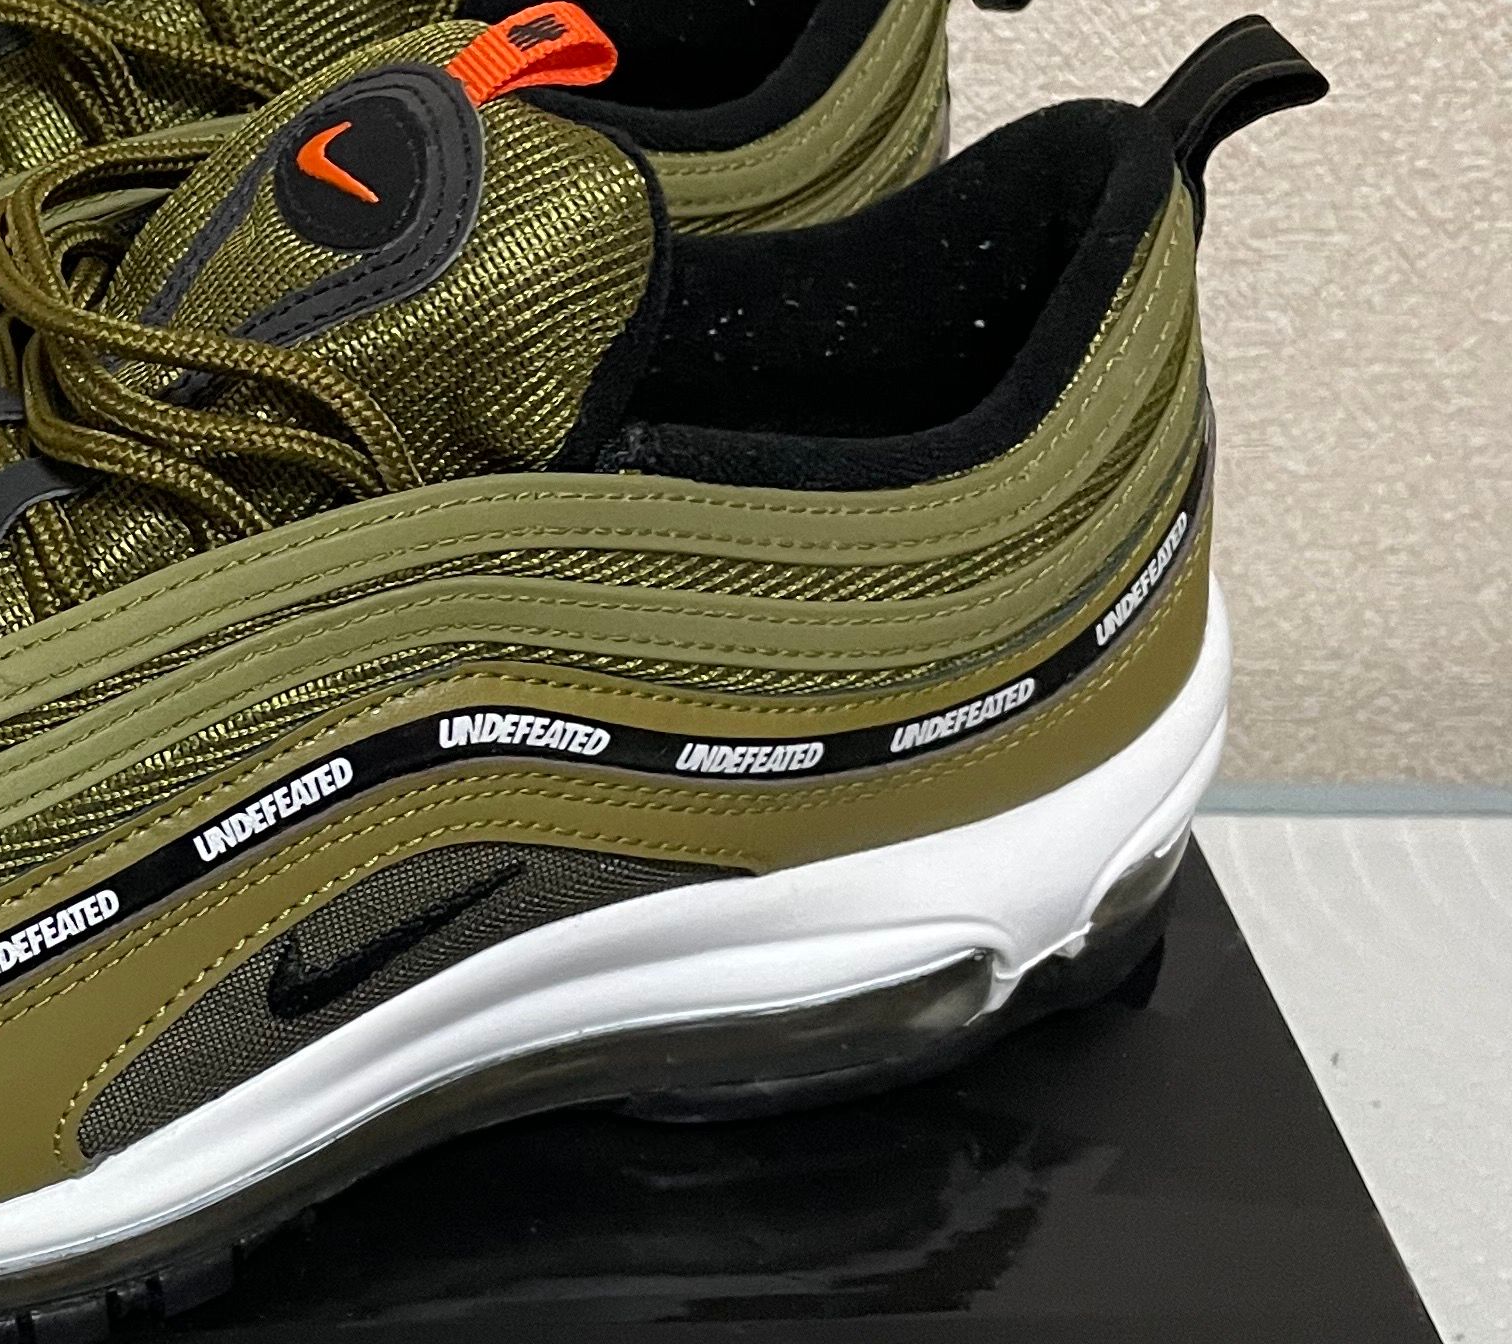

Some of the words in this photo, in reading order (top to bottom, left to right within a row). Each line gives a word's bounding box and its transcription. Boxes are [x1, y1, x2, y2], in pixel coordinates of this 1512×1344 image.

[1096, 512, 1187, 645] UNDEFEATED
[440, 713, 610, 756] UNDEFEATED
[891, 678, 1035, 752] UNDEFEATED
[676, 742, 824, 774] UNDEFEATED
[193, 757, 353, 862] UNDEFEATED
